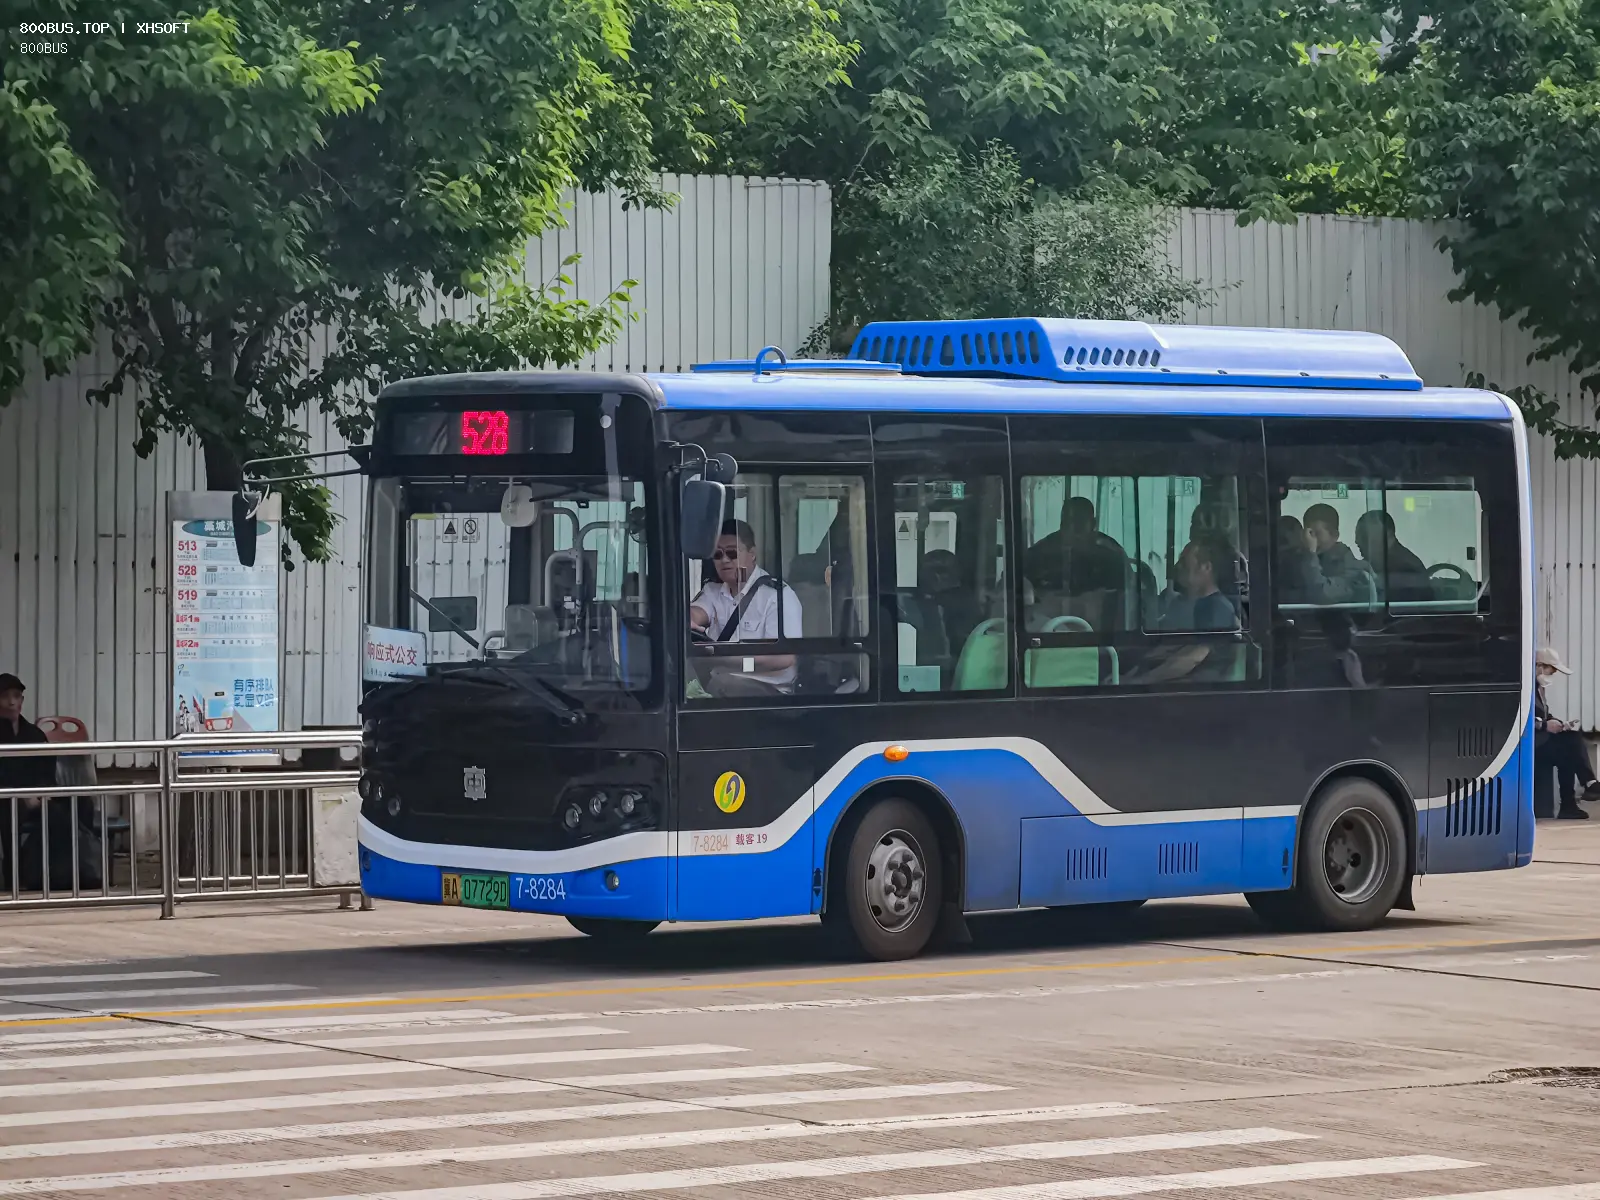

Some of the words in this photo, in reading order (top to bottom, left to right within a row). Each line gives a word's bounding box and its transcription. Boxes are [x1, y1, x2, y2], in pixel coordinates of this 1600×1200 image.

[461, 410, 509, 455] 528
[178, 540, 197, 551] 513
[178, 565, 197, 576] 528
[177, 589, 198, 600] 519
[367, 641, 418, 667] 响应式公交
[233, 678, 274, 693] 有序排队
[693, 833, 729, 852] 7-8284
[515, 877, 566, 900] 7-8284
